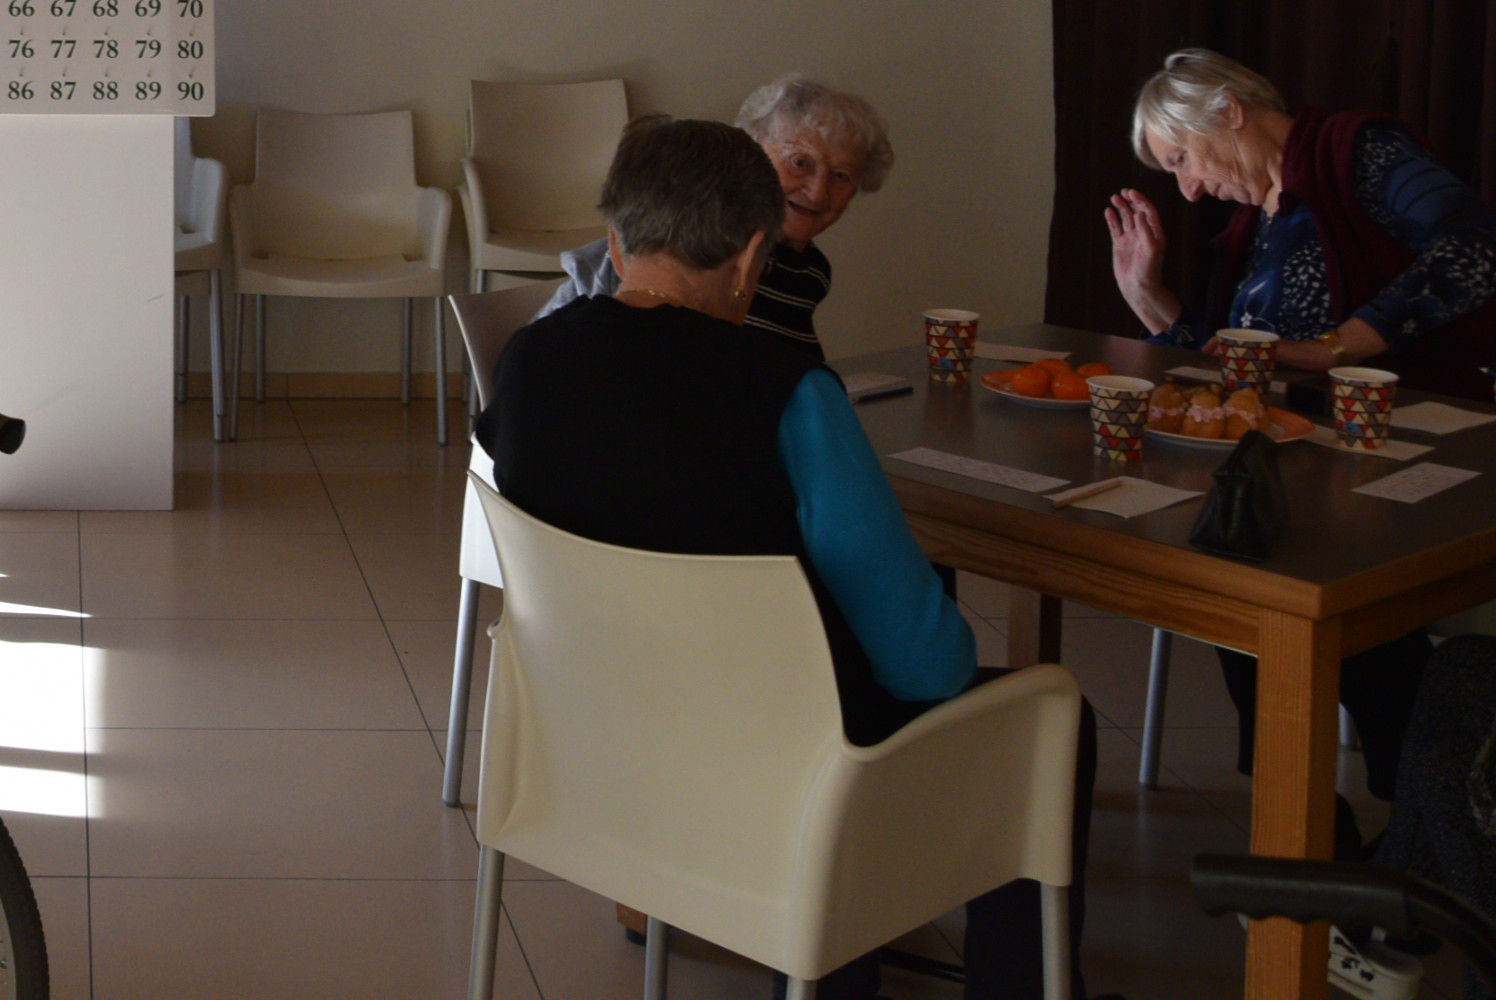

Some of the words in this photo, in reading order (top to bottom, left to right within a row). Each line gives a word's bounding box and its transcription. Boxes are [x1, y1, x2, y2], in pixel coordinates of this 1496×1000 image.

[8, 39, 35, 59] 76
[50, 39, 77, 59] 77
[92, 39, 119, 59] 78
[135, 39, 162, 59] 79
[177, 39, 204, 60] 80
[7, 80, 35, 100] 86
[49, 80, 77, 101] 87
[92, 80, 119, 101] 88
[135, 81, 162, 101] 89
[177, 81, 205, 101] 90
